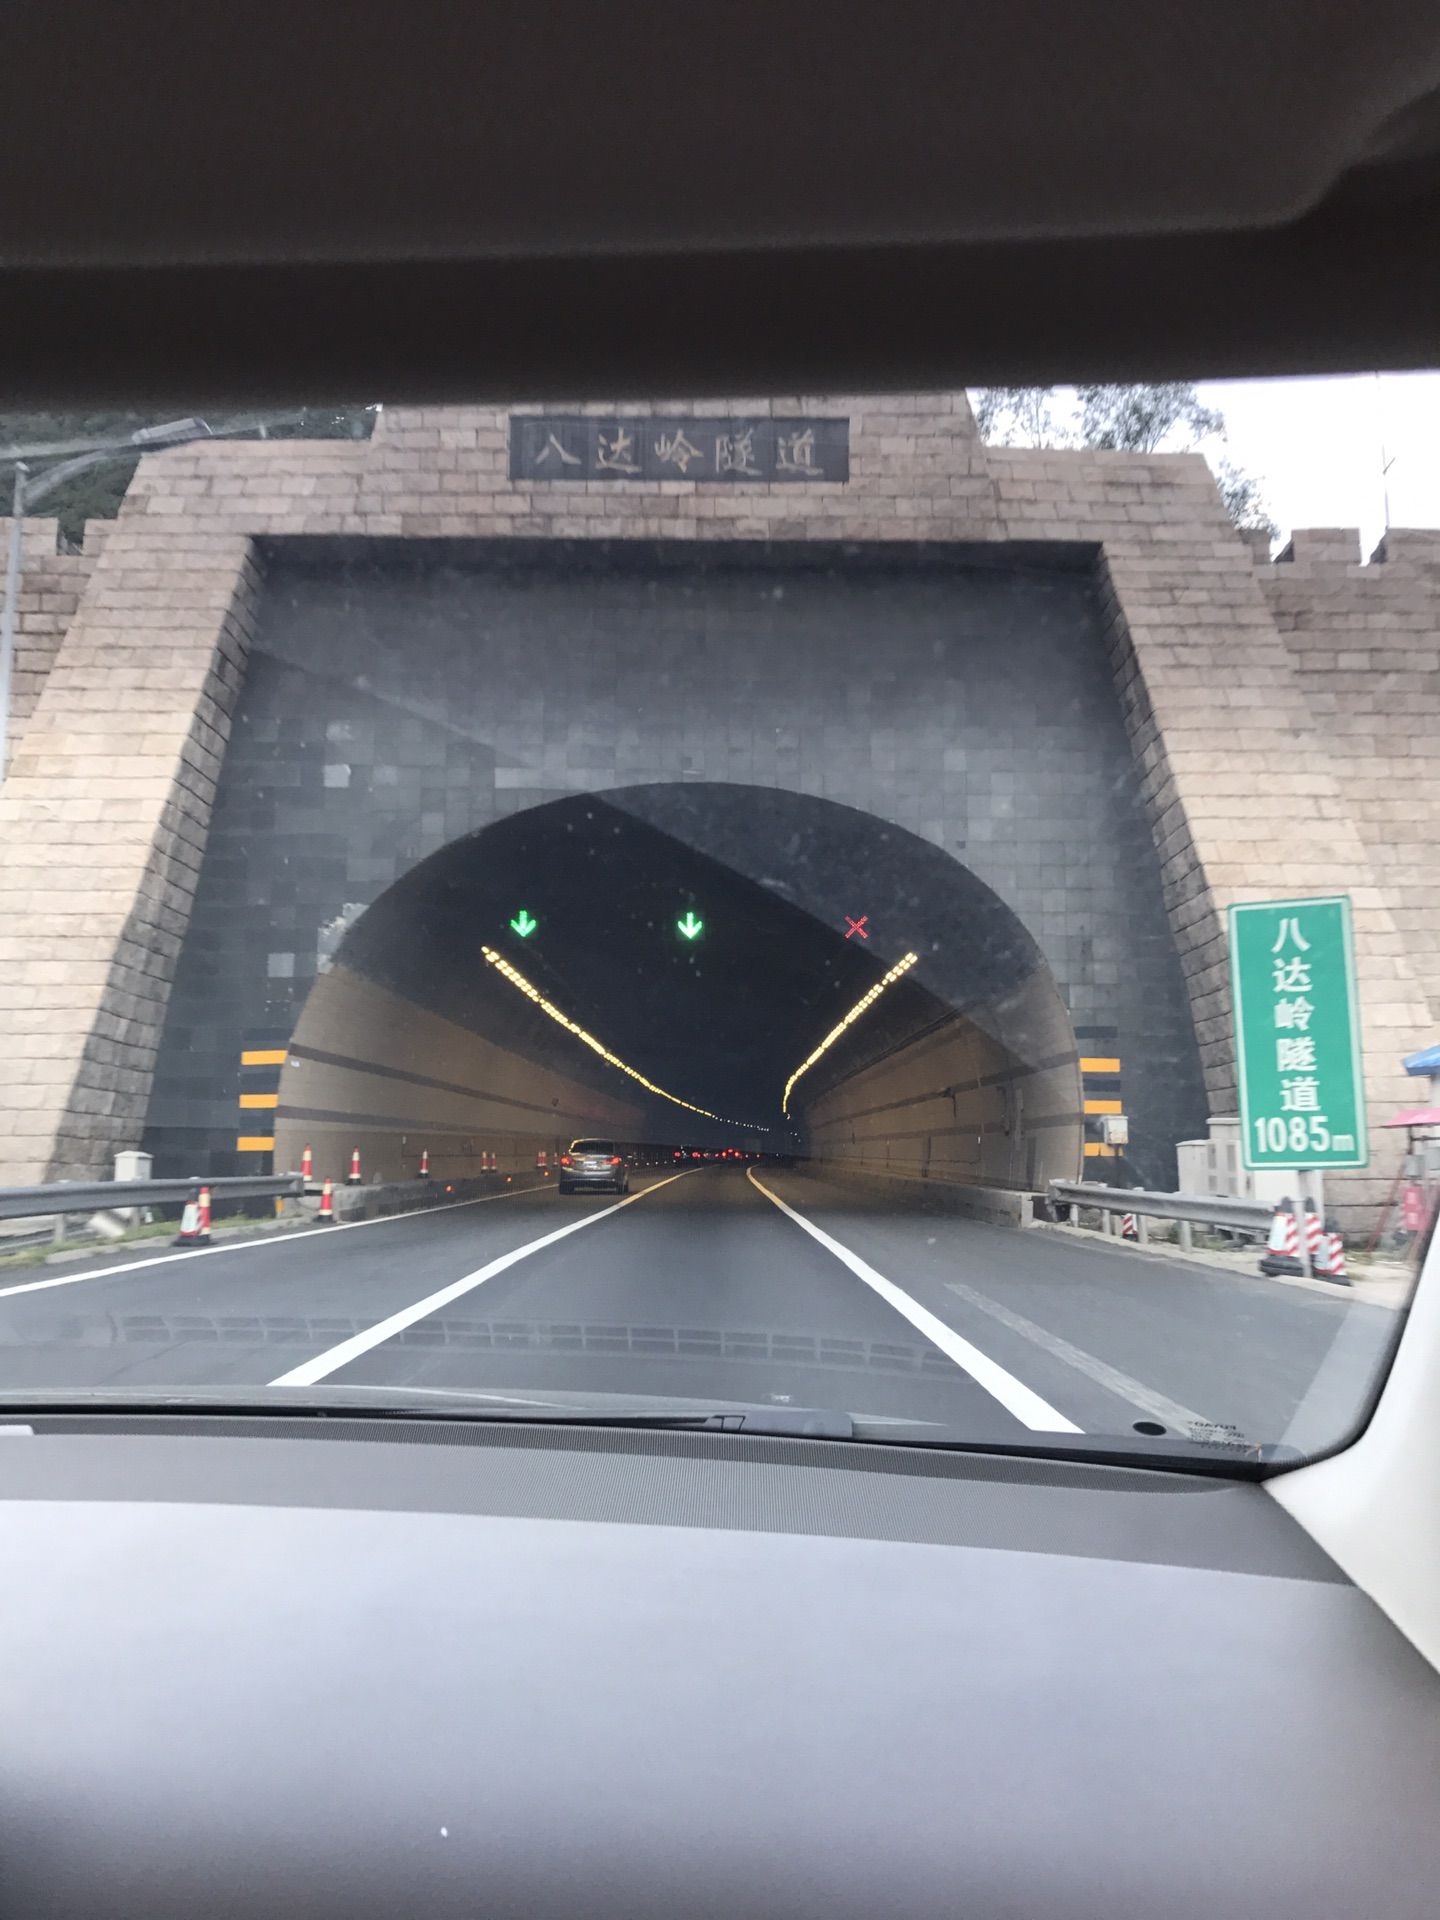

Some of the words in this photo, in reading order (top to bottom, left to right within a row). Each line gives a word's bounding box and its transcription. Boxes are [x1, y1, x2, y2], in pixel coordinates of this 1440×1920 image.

[535, 426, 824, 476] 八达岭隧道
[1270, 917, 1321, 1112] 八达岭隧道
[1254, 1115, 1355, 1153] 1085m
